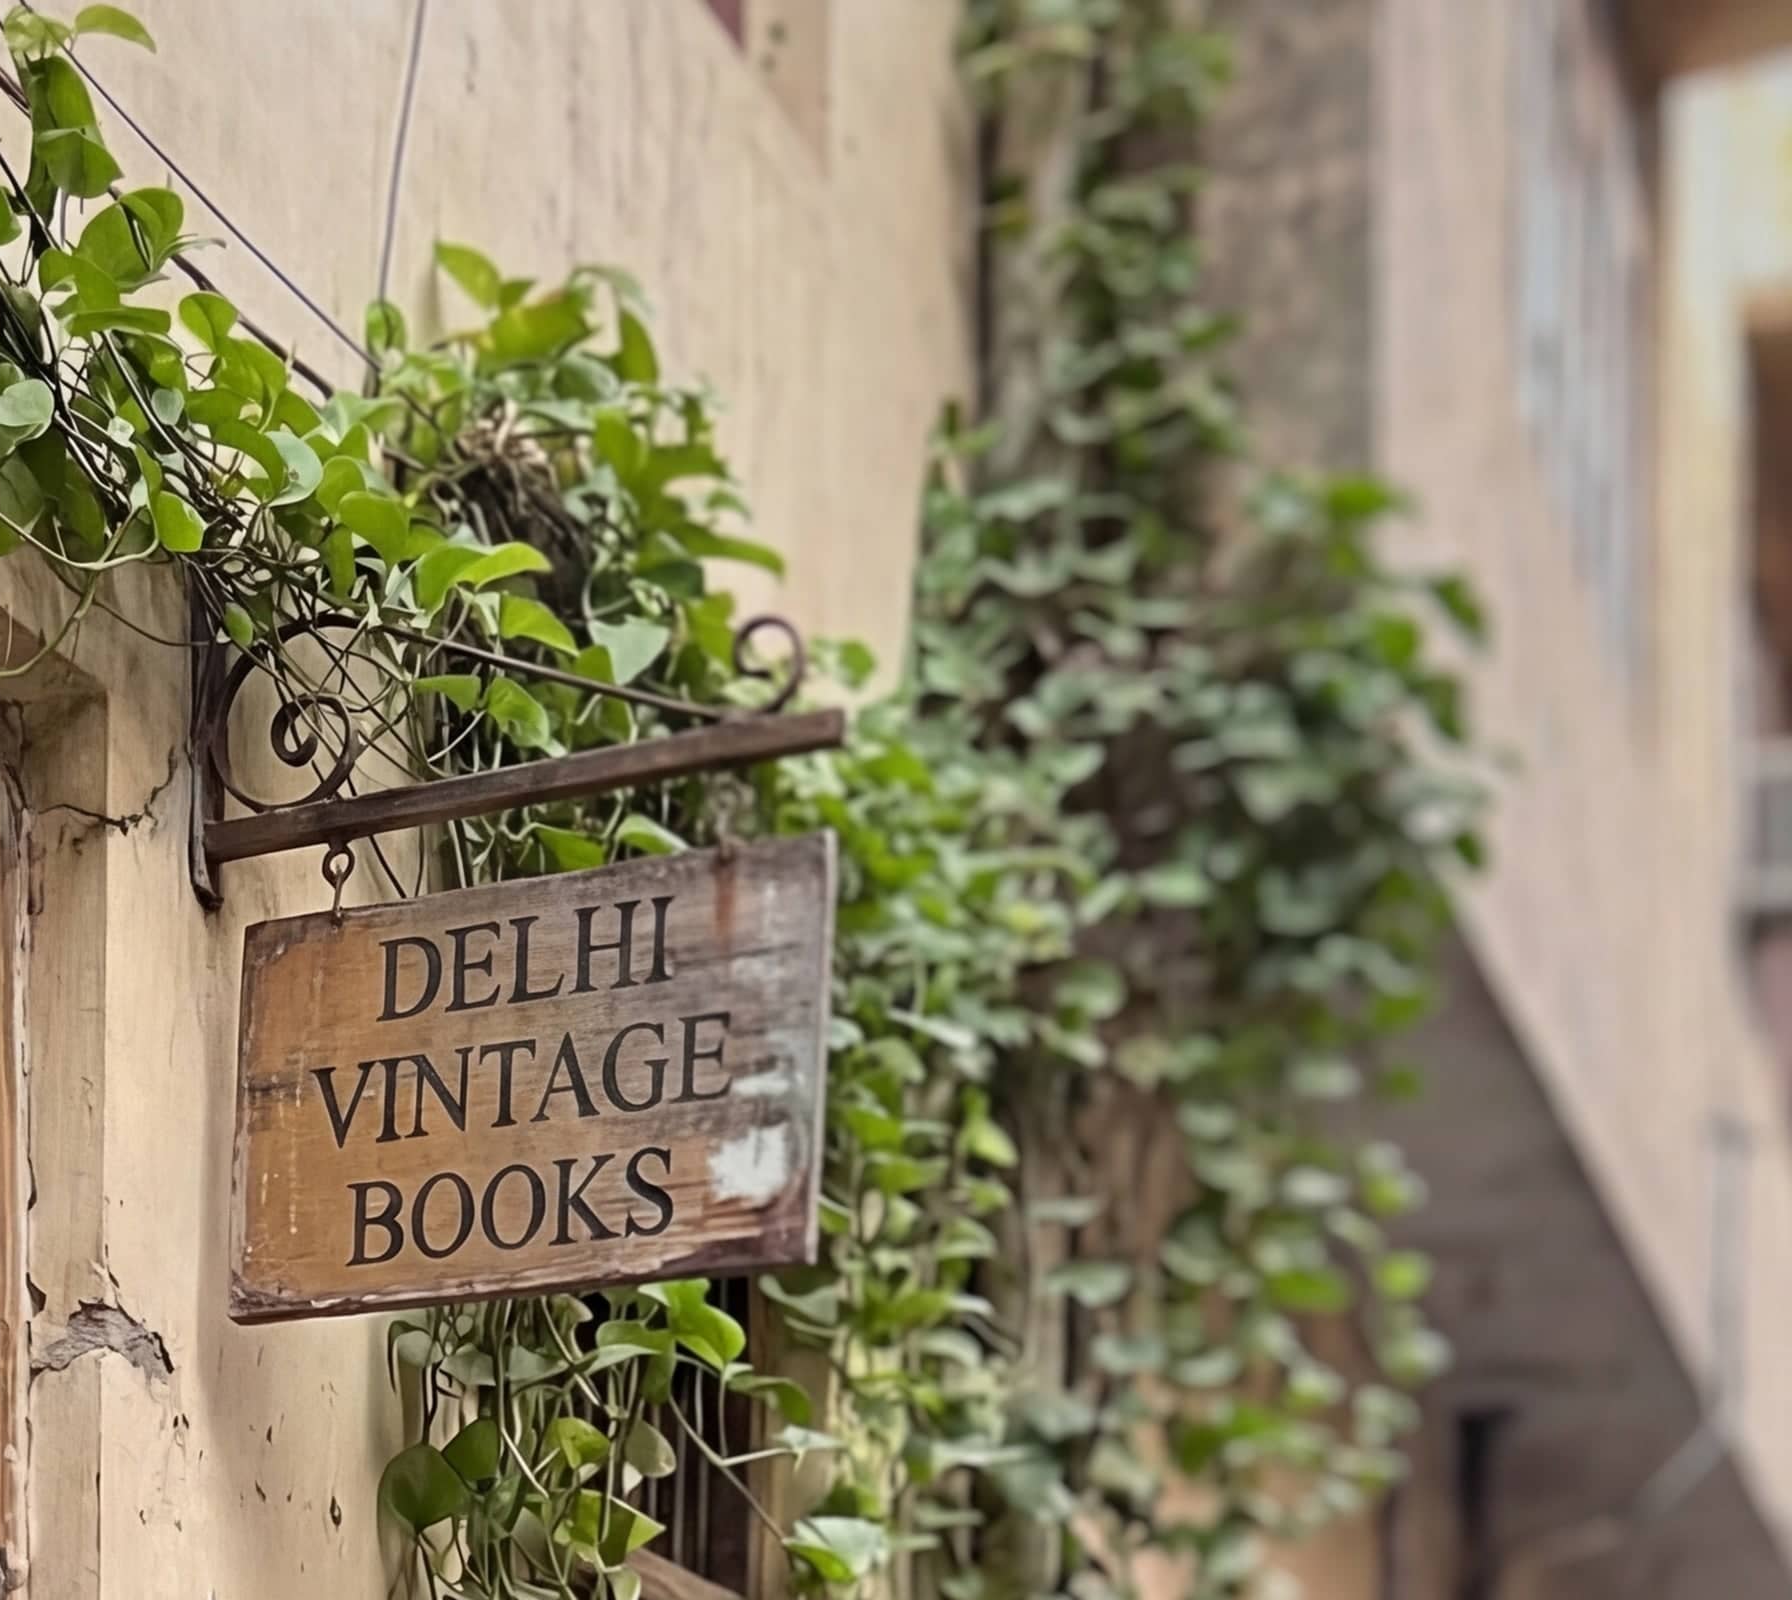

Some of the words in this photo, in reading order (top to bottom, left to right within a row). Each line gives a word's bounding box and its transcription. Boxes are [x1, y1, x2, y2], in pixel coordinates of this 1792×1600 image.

[376, 895, 676, 1022] DELHI
[309, 1011, 732, 1149] VINTAGE
[345, 1146, 675, 1267] BOOKS
